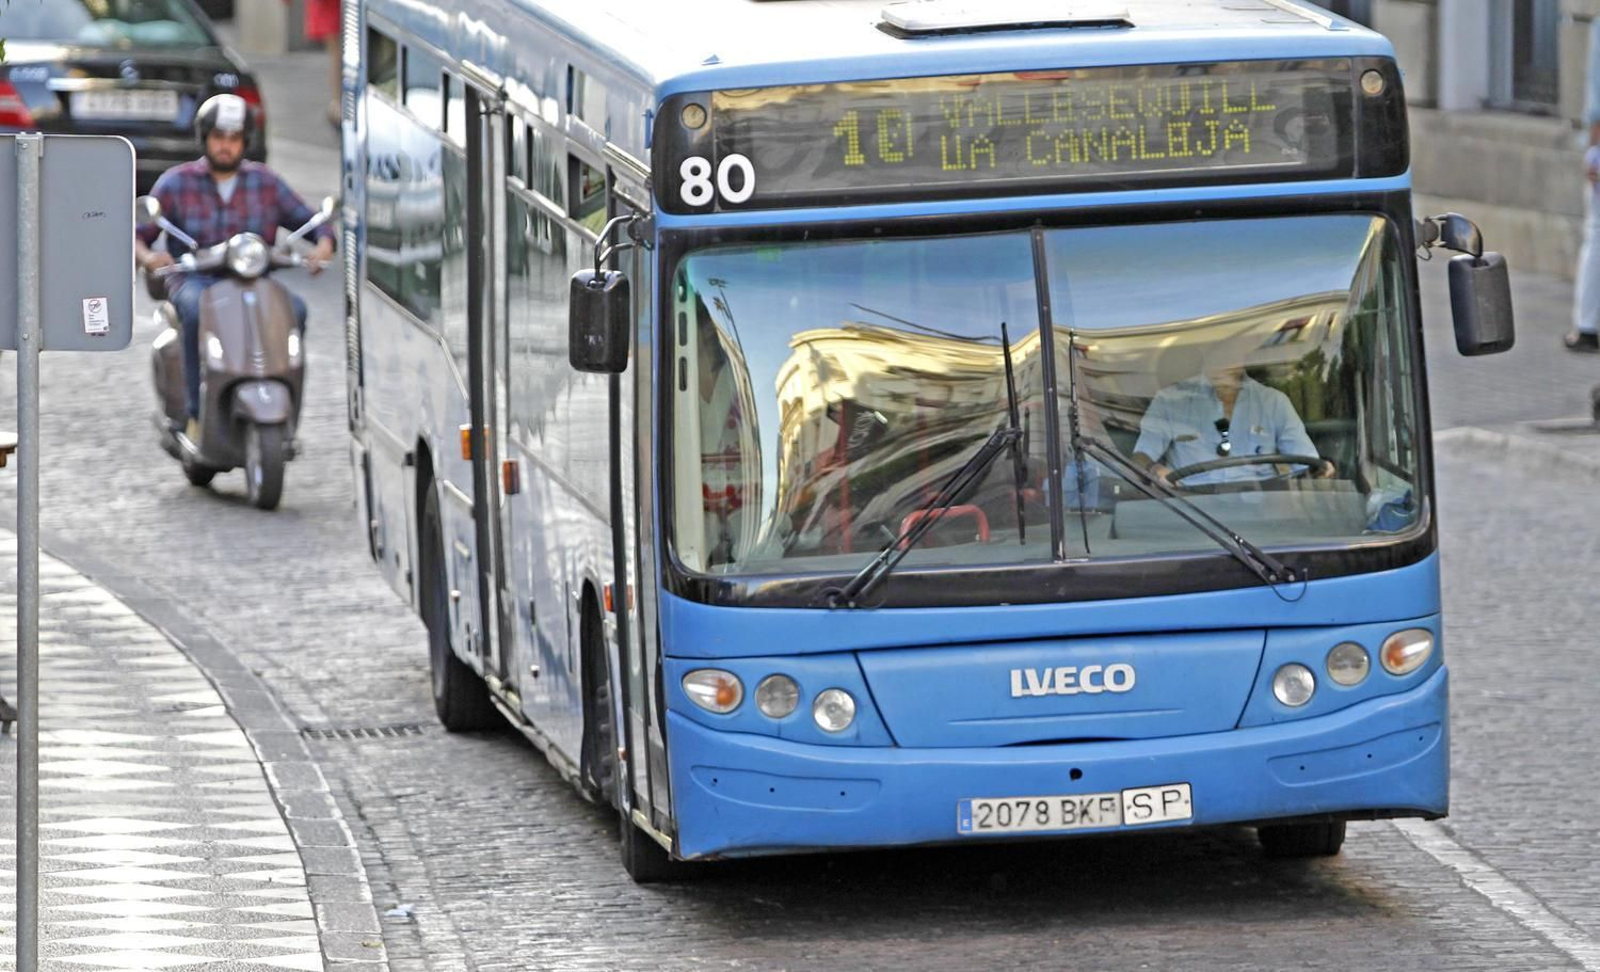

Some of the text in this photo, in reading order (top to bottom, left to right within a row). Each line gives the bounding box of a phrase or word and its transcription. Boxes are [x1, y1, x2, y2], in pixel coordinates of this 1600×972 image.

[680, 153, 755, 206] 80
[1010, 663, 1136, 697] IVECO
[977, 800, 1050, 829] 2078
